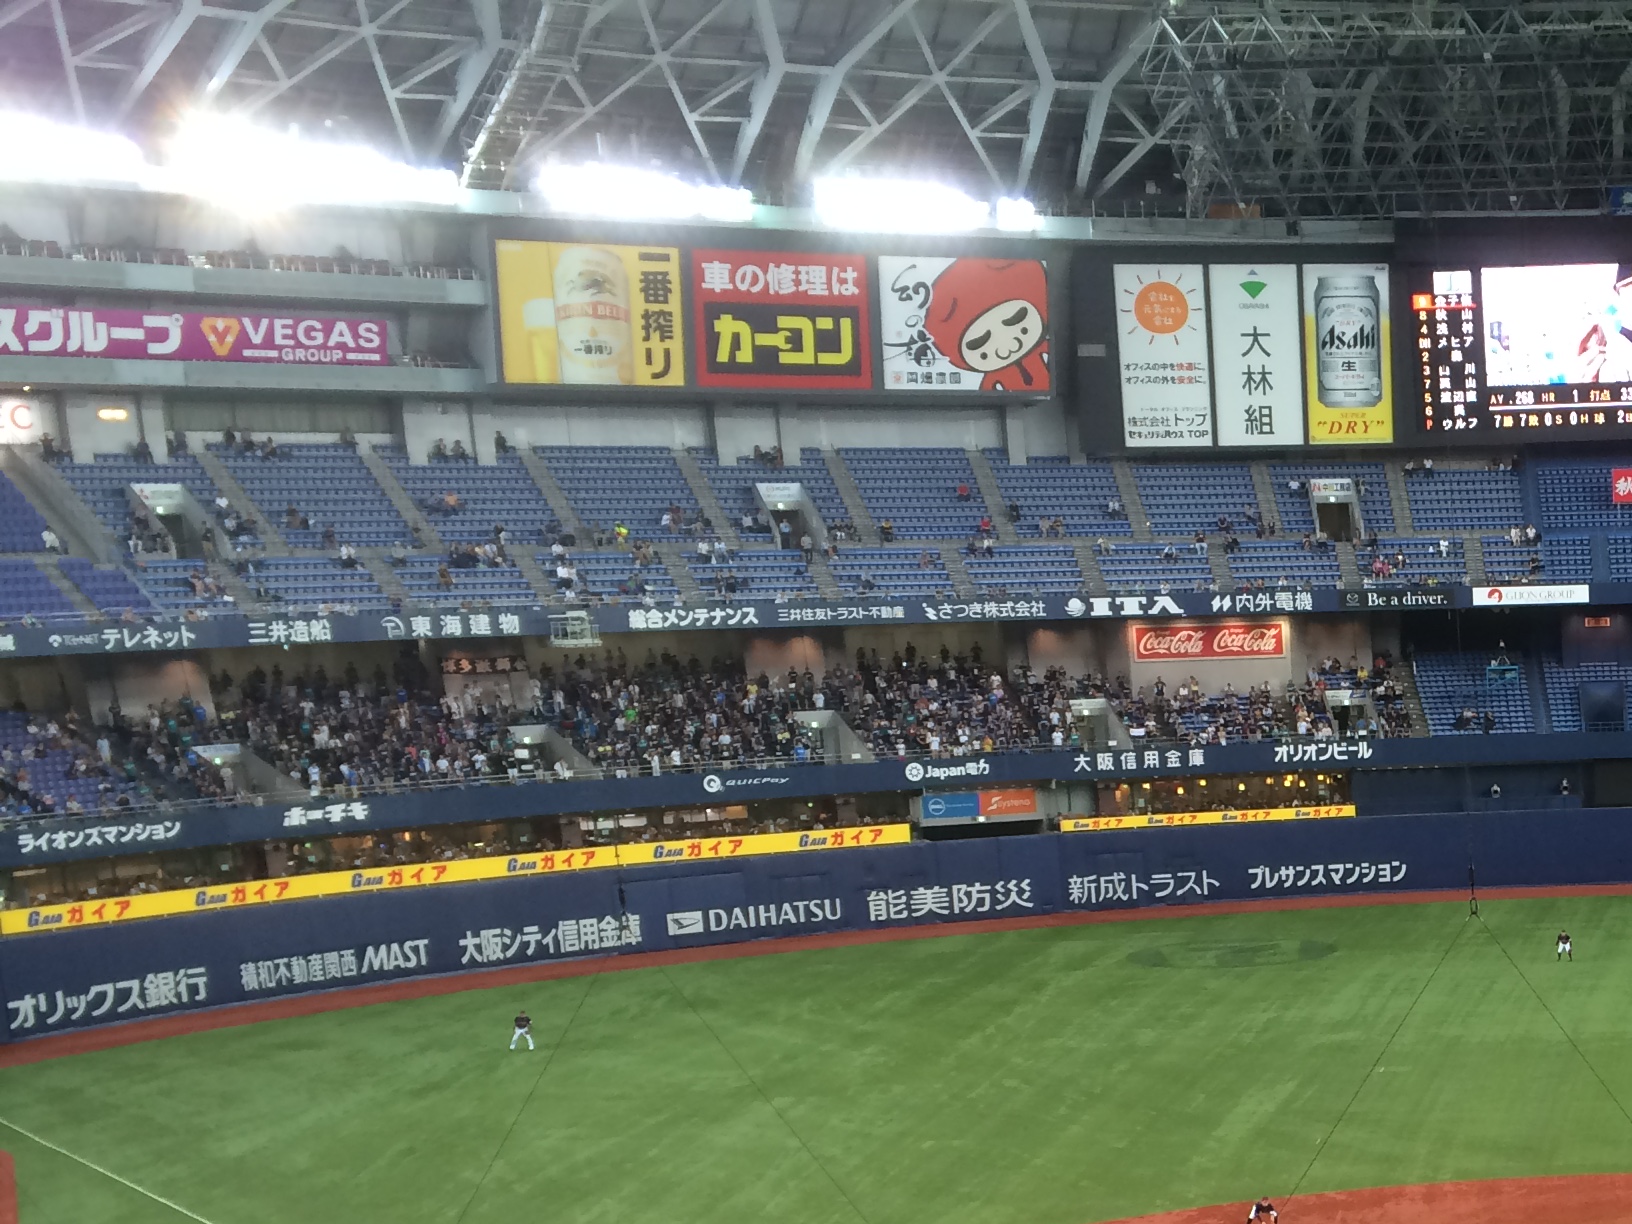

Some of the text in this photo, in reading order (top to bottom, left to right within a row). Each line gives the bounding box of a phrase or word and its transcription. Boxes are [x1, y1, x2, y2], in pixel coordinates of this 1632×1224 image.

[701, 260, 860, 297] 車の修理は
[638, 251, 674, 380] 一番搾り
[241, 317, 381, 349] VEGAS
[713, 313, 853, 367] カーコン
[1321, 323, 1376, 351] Asahi
[281, 348, 343, 363] GROUP
[1341, 360, 1357, 372] 生
[1239, 325, 1275, 436] 大林組
[1541, 392, 1556, 403] HR
[1187, 429, 1209, 439] TOP
[1442, 417, 1479, 431] ウルフ
[1235, 591, 1314, 614] 内外電機
[1367, 590, 1448, 606] Be a driver.
[1539, 589, 1576, 601] GROUP
[627, 606, 760, 630] 総合メンテナンス
[777, 605, 906, 622] 三井住友トラスト不動産
[937, 600, 1047, 619] さつき株式会社
[248, 619, 331, 644] 三井造船
[409, 612, 521, 637] 東海建物
[100, 624, 196, 650] テレネット
[1073, 748, 1206, 773] 大阪信用金庫
[1273, 740, 1373, 764] オリオンビール
[924, 757, 991, 780] Japan電力
[283, 802, 371, 827] ホーチキ
[17, 821, 182, 853] ライオンズマンション
[687, 837, 744, 858] ガイア
[830, 829, 885, 847] ガイア
[540, 850, 596, 871] ガイア
[387, 864, 448, 886] ガイア
[1246, 858, 1409, 890] プレサンスマンション
[230, 880, 290, 904] ガイア
[1067, 870, 1221, 905] 新成トラスト
[66, 900, 132, 924] ガイア
[866, 878, 1036, 922] 能美防災
[708, 896, 842, 932] DAIHATSU
[457, 911, 643, 965] 大阪シティ信用金庫
[239, 939, 430, 993] 積和不動産関西 MAST
[8, 966, 209, 1030] オリックス銀行
